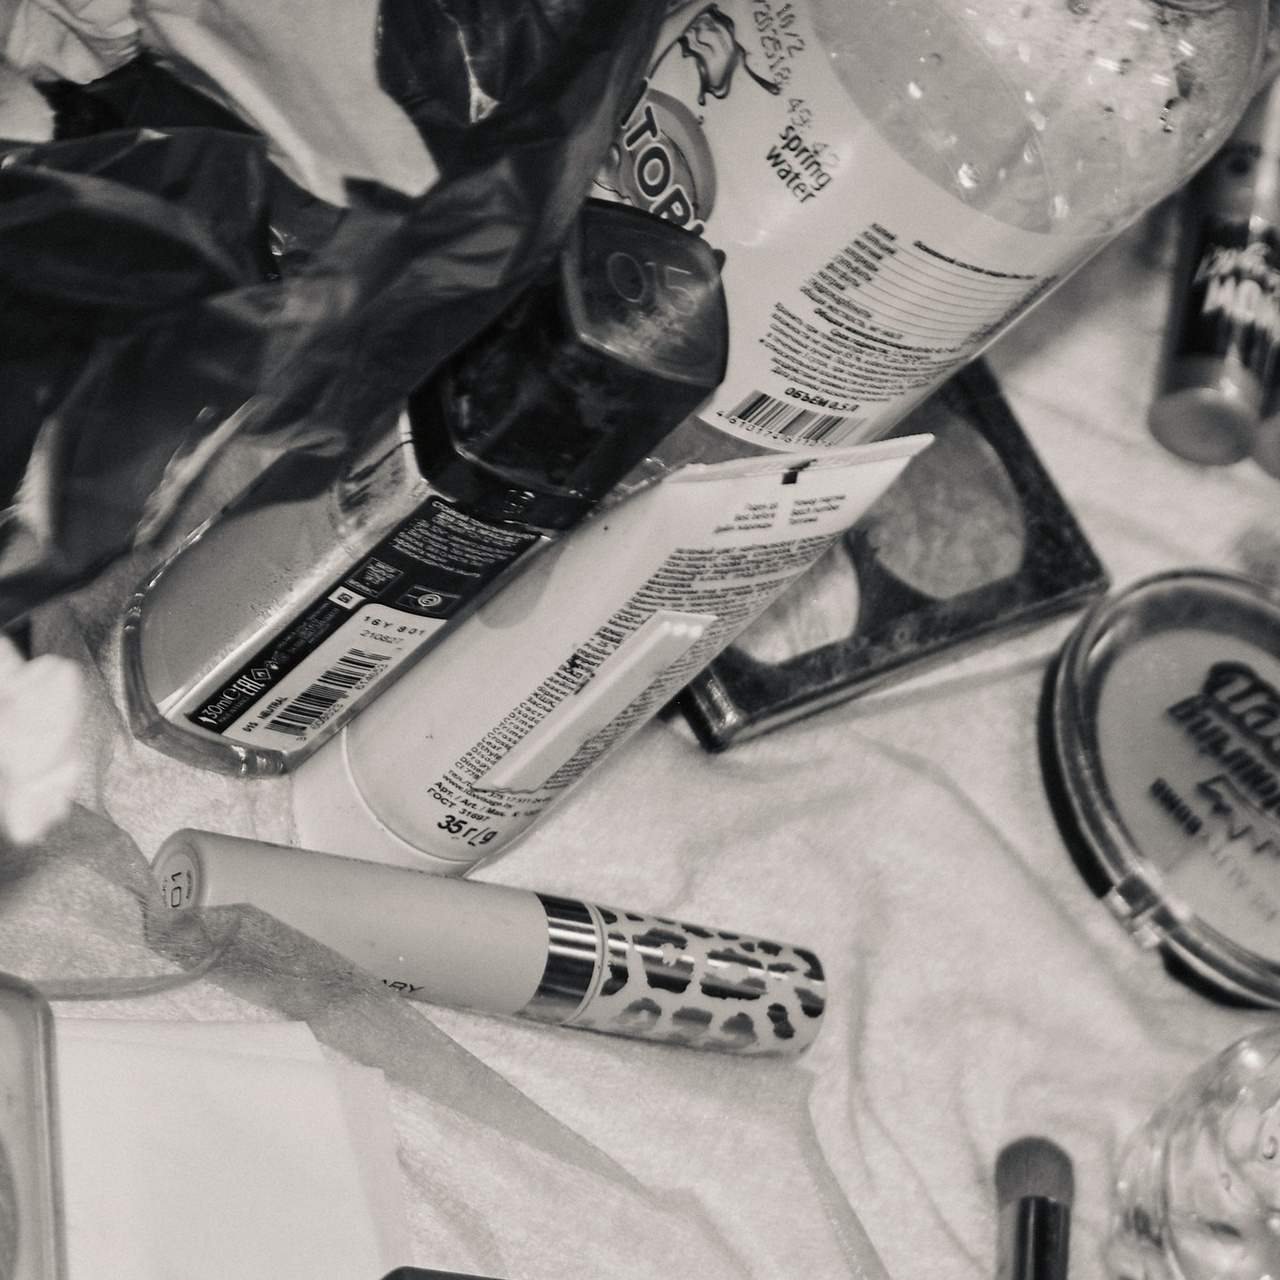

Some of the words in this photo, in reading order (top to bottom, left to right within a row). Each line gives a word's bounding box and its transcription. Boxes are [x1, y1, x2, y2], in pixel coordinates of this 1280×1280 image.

[779, 124, 832, 192] spring
[766, 145, 818, 203] water
[359, 628, 404, 646] 210827
[363, 614, 394, 629] 16Y
[202, 692, 232, 723] 30ml
[255, 691, 288, 723] NEUTRAL
